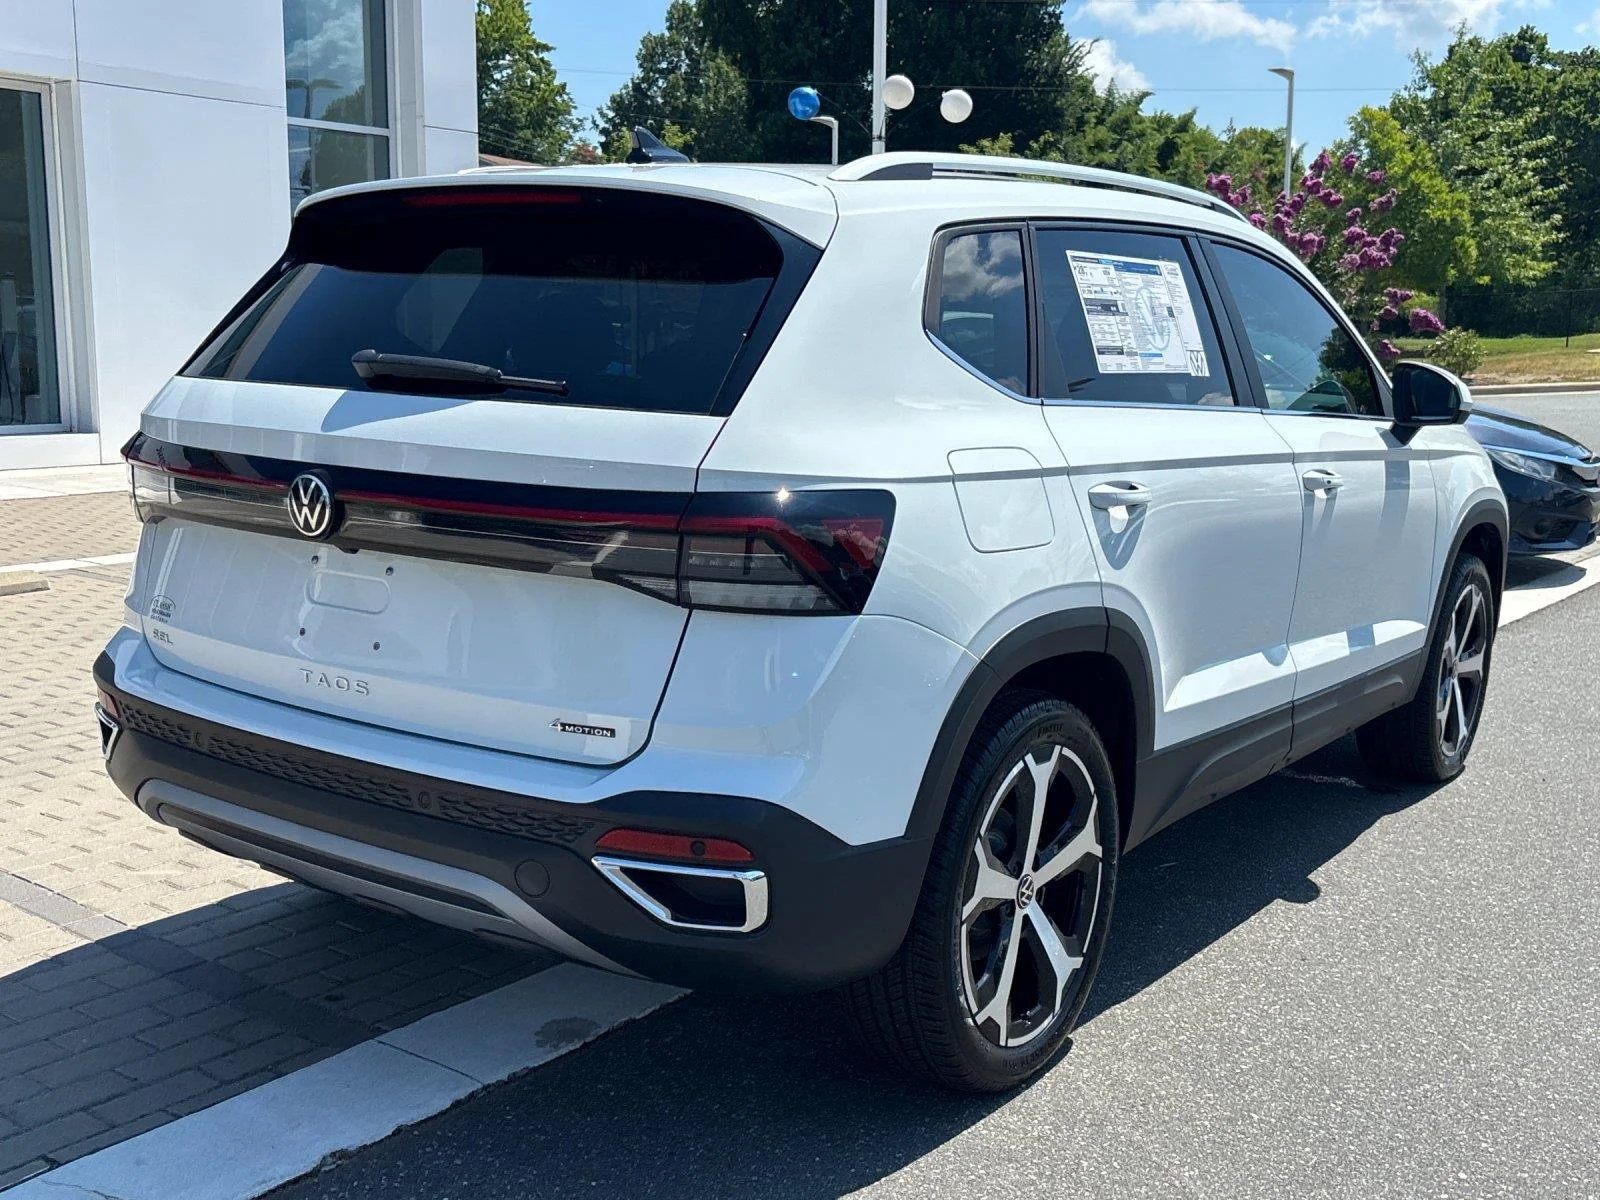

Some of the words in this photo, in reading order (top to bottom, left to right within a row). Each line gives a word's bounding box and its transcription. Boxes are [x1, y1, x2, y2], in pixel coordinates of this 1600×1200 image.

[290, 476, 328, 533] VW
[299, 667, 369, 696] TAOS
[549, 718, 613, 737] 4MOTION
